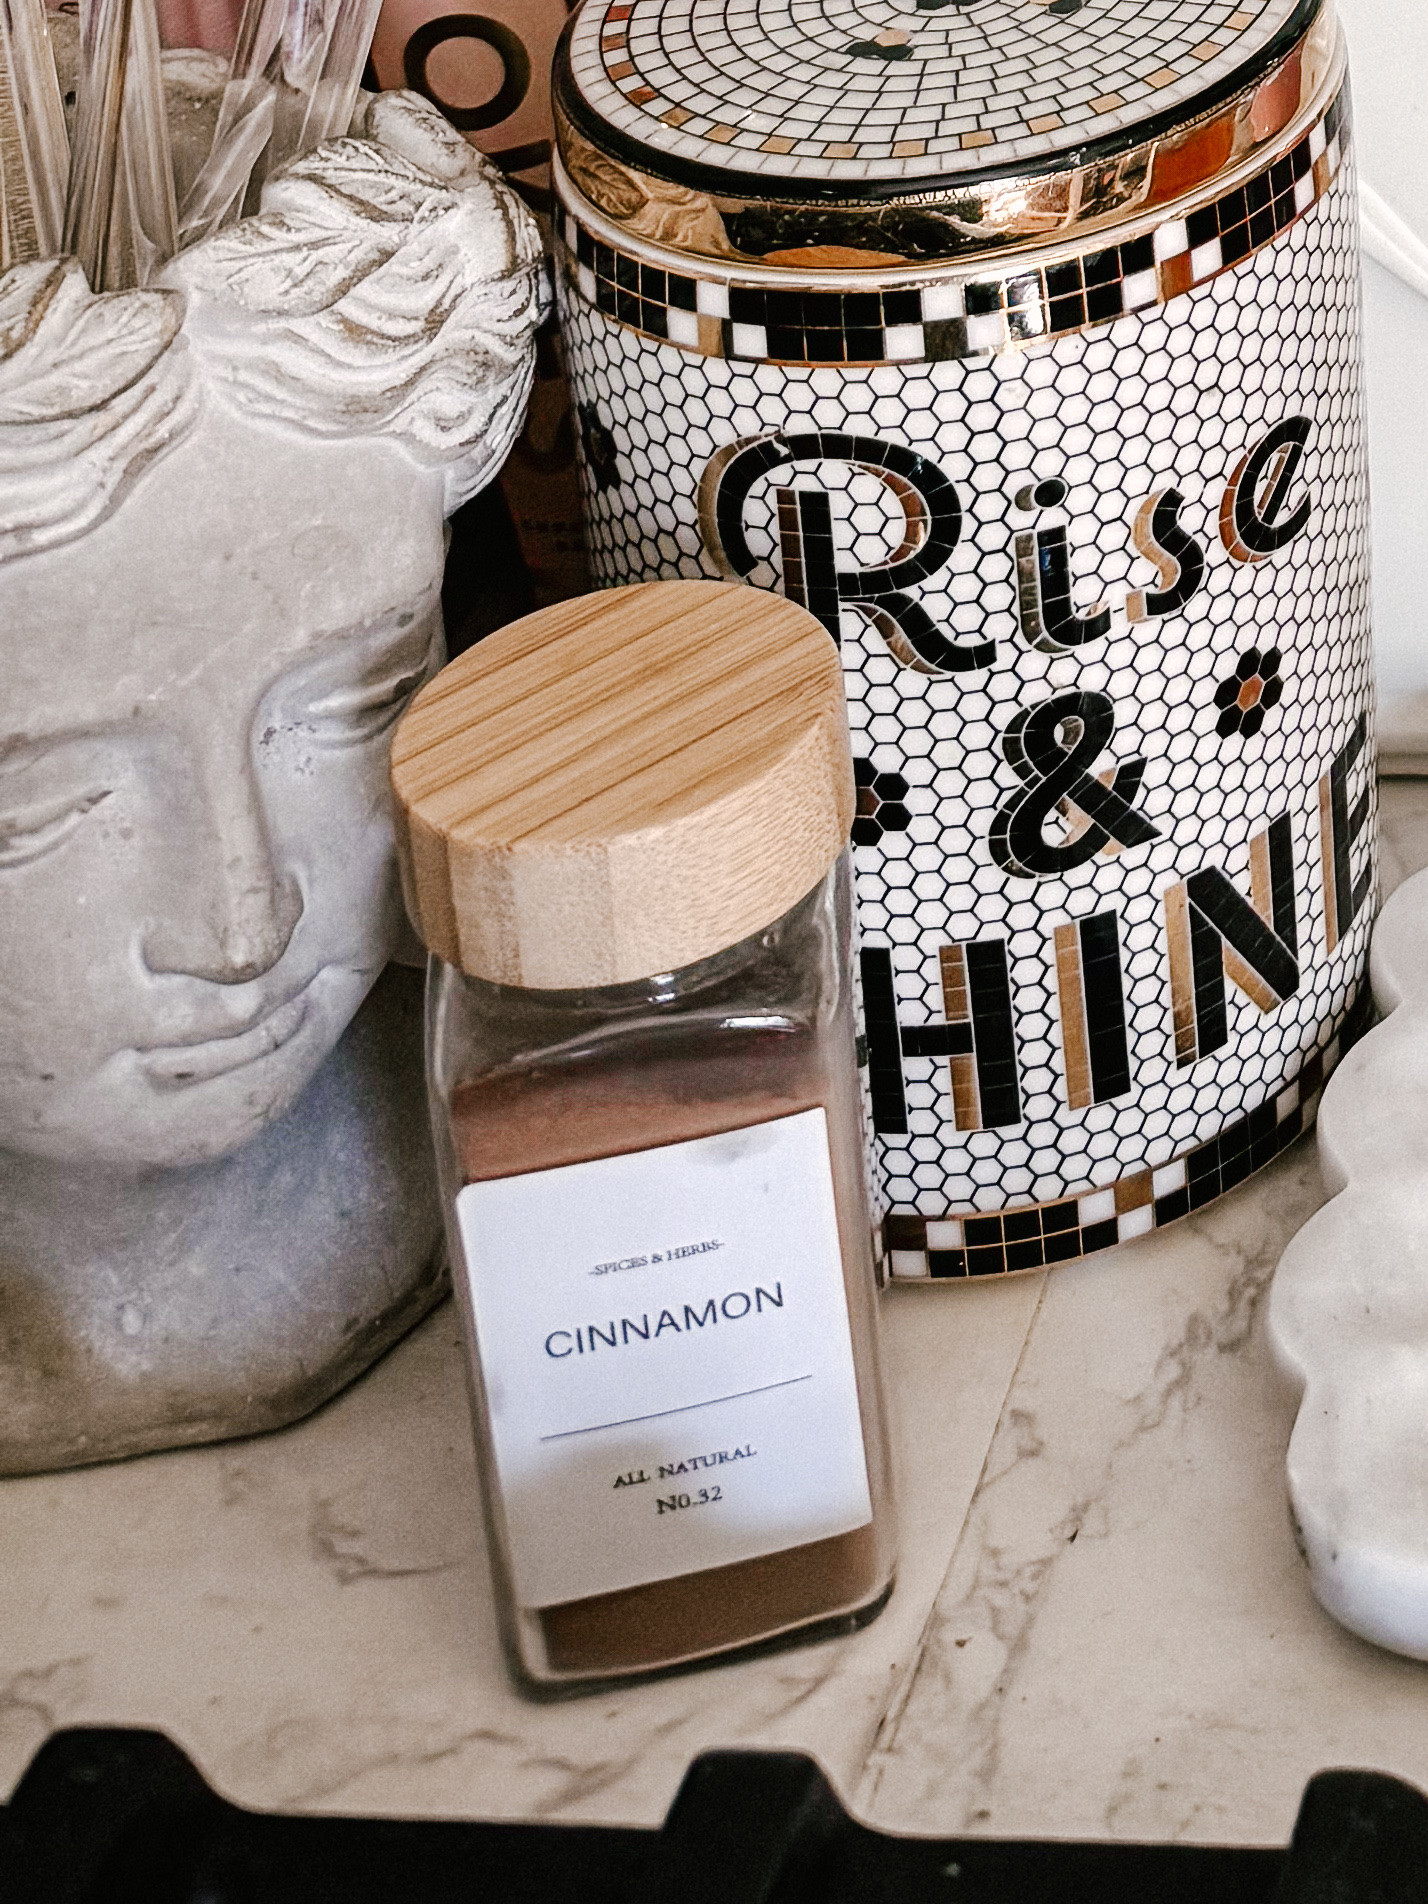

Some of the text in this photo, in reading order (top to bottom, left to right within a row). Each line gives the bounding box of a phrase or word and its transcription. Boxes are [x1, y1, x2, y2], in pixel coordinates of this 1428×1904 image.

[698, 414, 1313, 676] Rise
[988, 690, 1163, 879] &
[857, 712, 1374, 1135] HINE
[543, 1280, 785, 1360] CINNAMON
[612, 1443, 758, 1489] ALL NATURAL
